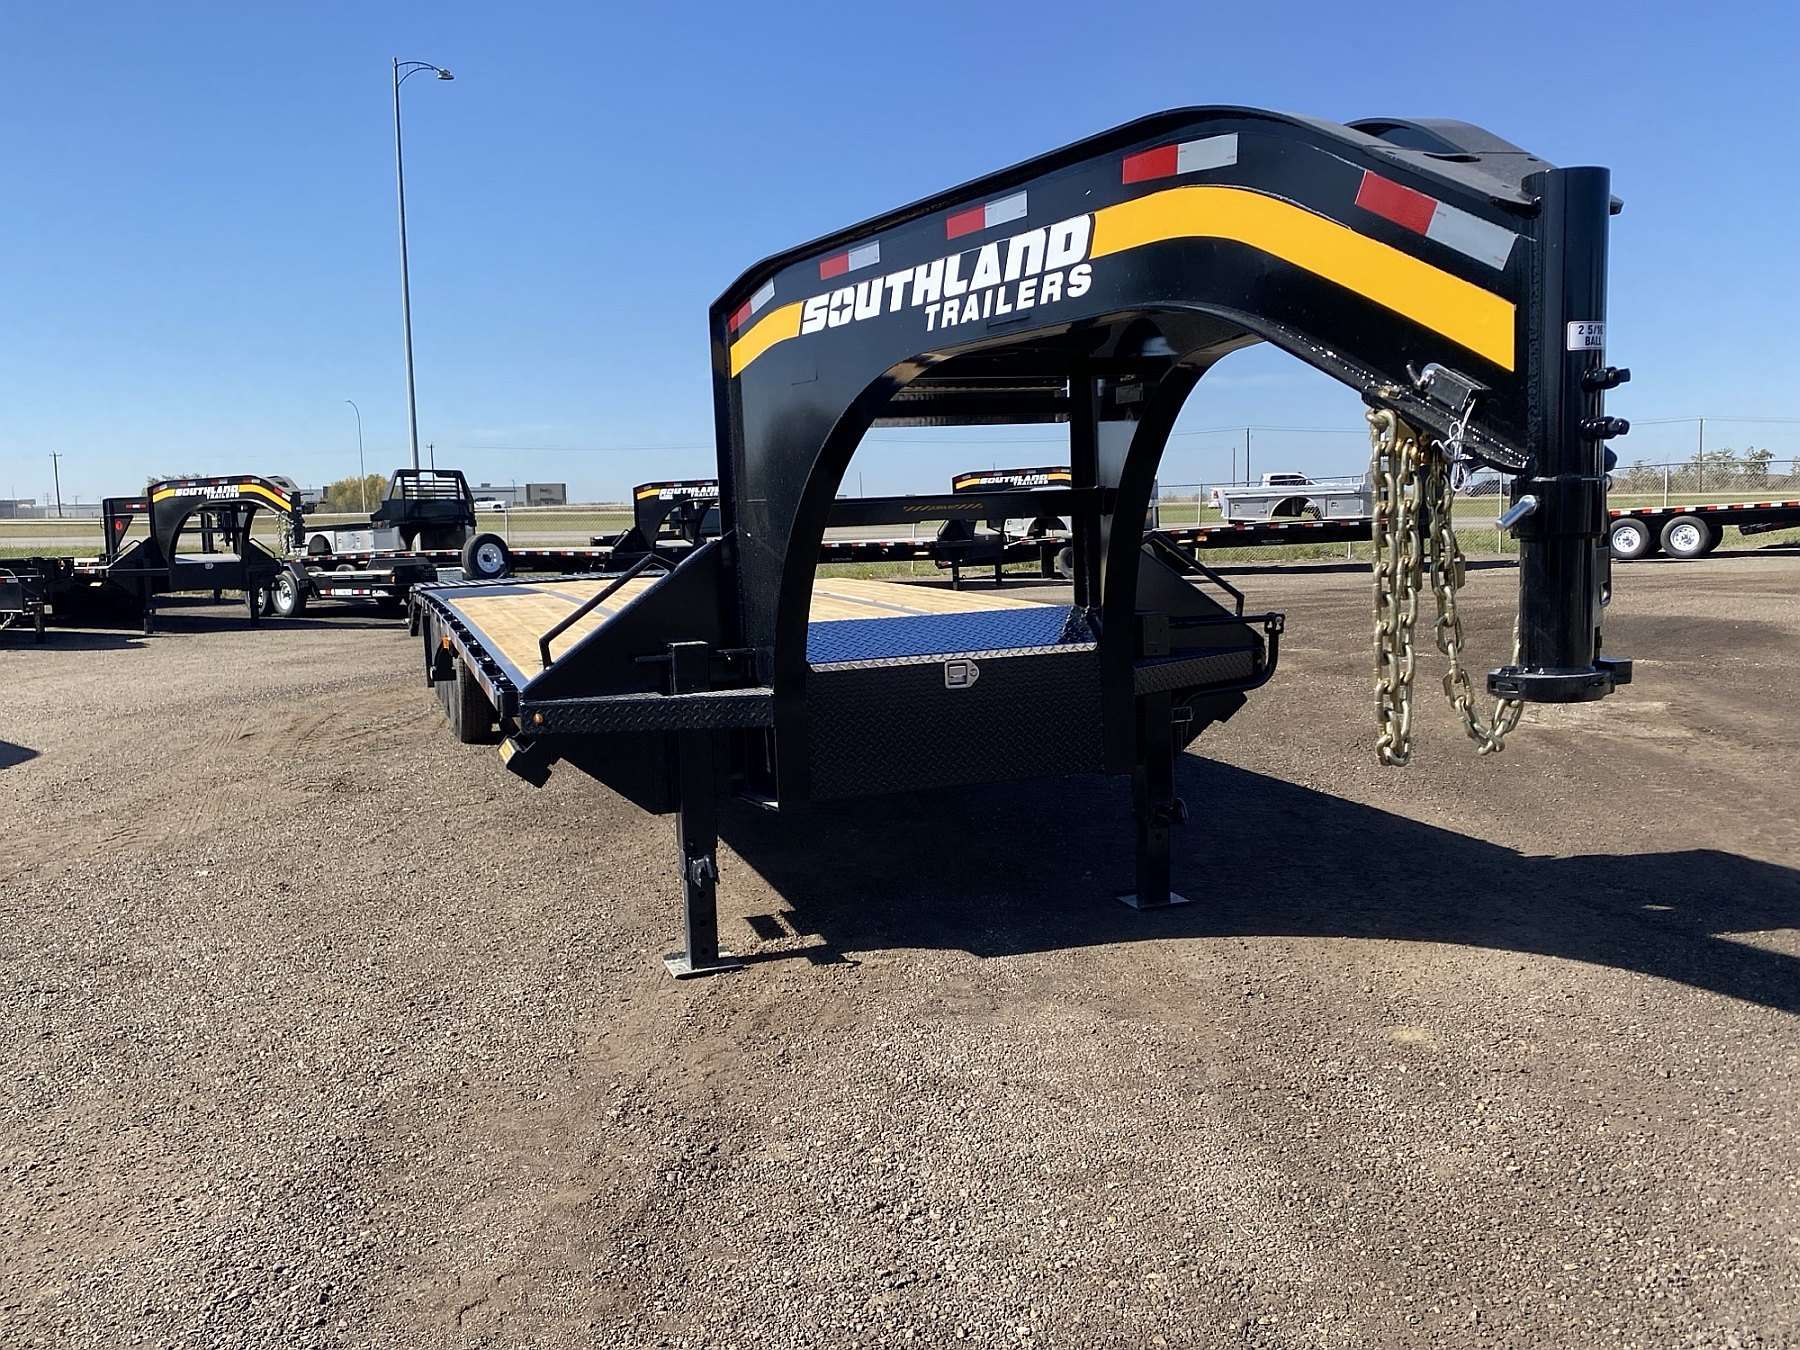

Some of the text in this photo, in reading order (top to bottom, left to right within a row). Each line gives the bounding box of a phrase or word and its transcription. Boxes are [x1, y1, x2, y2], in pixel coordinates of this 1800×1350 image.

[801, 213, 1092, 335] SOUTHLAND
[924, 263, 1093, 332] TRAILERS
[1578, 324, 1585, 335] 2
[1584, 336, 1602, 346] BALL
[979, 474, 1048, 484] SOUTHLAND
[175, 485, 239, 497] SOUTHLAND
